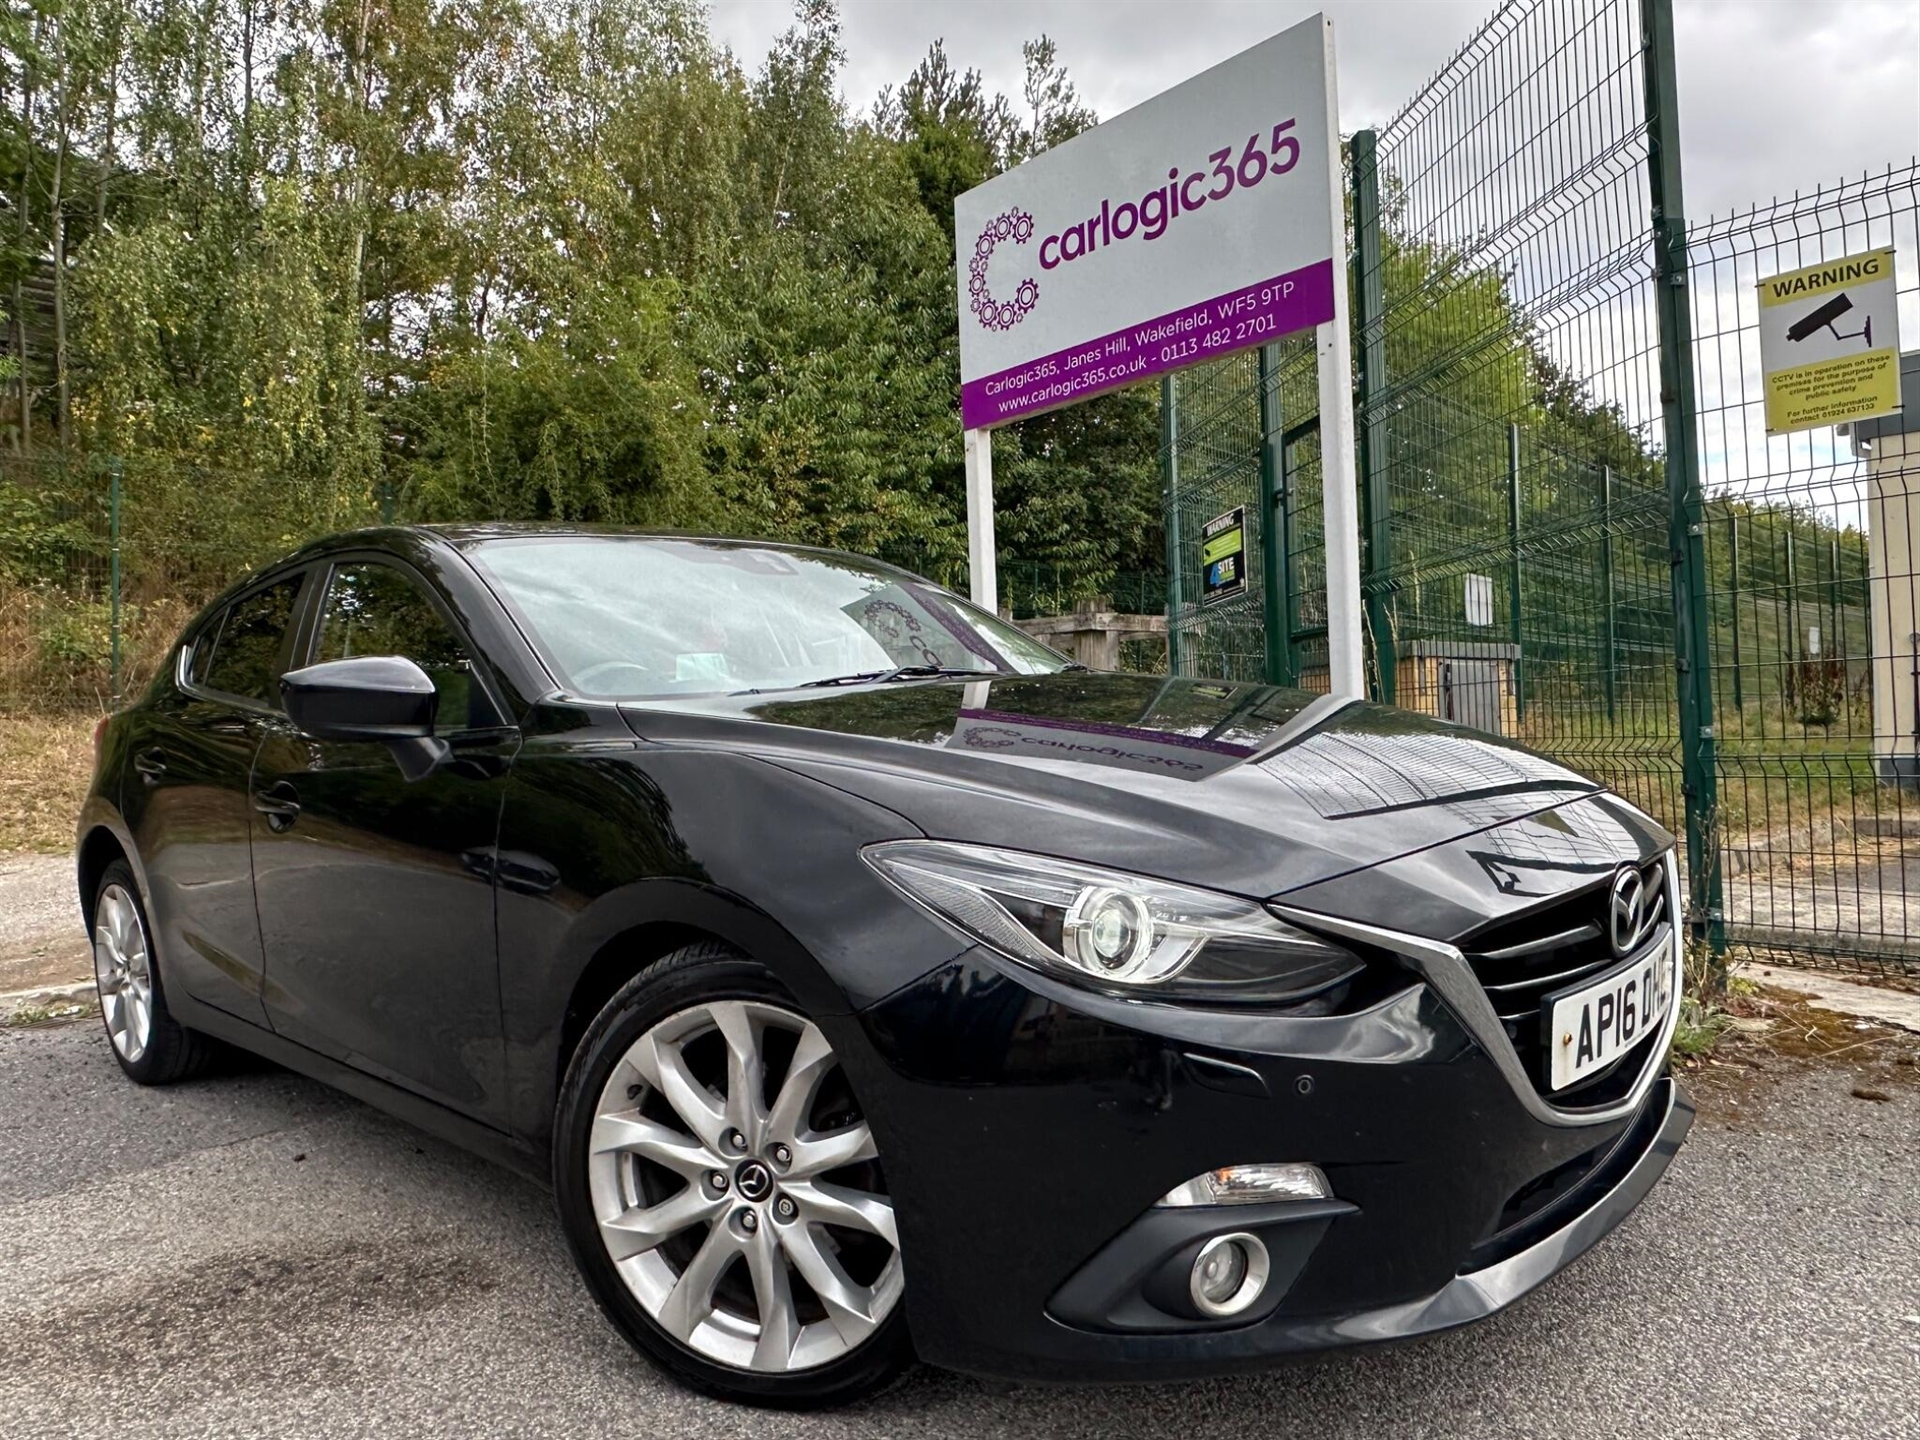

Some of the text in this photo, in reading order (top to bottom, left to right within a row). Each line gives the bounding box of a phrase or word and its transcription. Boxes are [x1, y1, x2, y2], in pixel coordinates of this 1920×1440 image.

[1039, 118, 1300, 269] carlogic365
[1773, 259, 1879, 297] WARNING
[985, 281, 1295, 396] Carlogic365, Janes Hill, Wakefield, WF5 9TP
[998, 355, 1147, 413] www.carlogic365.co.uk
[1161, 337, 1197, 362] 0113
[1202, 327, 1230, 348] 482
[1236, 313, 1277, 340] 2701
[1772, 374, 1794, 384] CCTV
[1814, 362, 1853, 376] operation
[1867, 354, 1890, 364] these
[1776, 362, 1887, 392] premises for the purpose of
[1789, 373, 1873, 396] crime prevention and
[1805, 384, 1857, 401] public safety
[1787, 395, 1878, 418] For further information
[1790, 413, 1820, 425] contact
[1822, 409, 1845, 418] 01924
[1575, 979, 1636, 1069] AP16
